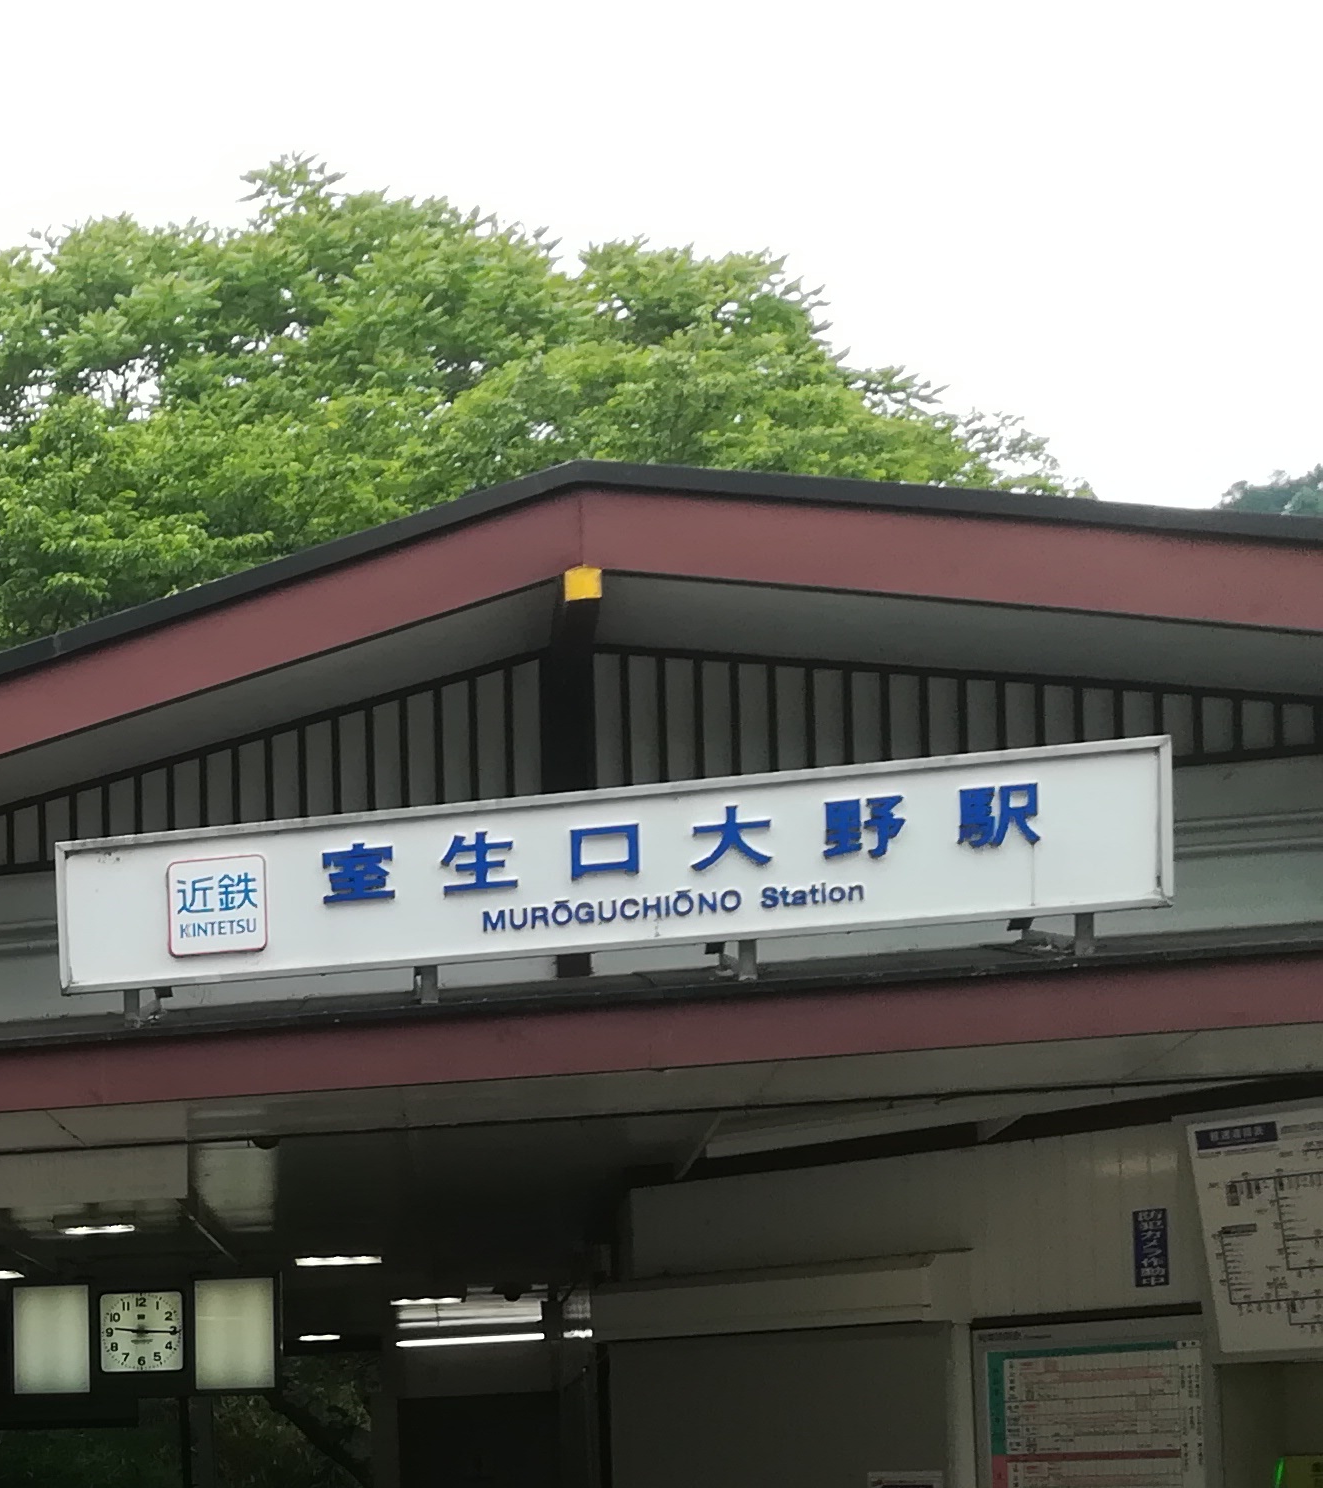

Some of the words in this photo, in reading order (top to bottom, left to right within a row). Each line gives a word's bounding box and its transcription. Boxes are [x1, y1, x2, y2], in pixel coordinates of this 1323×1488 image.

[321, 781, 1043, 908] 室生口大野駅
[177, 872, 257, 914] 近鉄
[760, 882, 864, 910] Station
[180, 918, 256, 938] KINTETSU
[1138, 1211, 1166, 1285] 防犯カメラ作動中
[121, 1300, 131, 1311] 11
[135, 1296, 148, 1308] 12
[155, 1300, 161, 1310] 1
[109, 1312, 121, 1324] 10
[164, 1310, 173, 1322] 2
[105, 1326, 113, 1338] 9
[109, 1342, 119, 1352] 8
[165, 1340, 174, 1352] 4
[121, 1352, 131, 1363] 7
[137, 1355, 147, 1366] 6
[153, 1351, 162, 1363] 5
